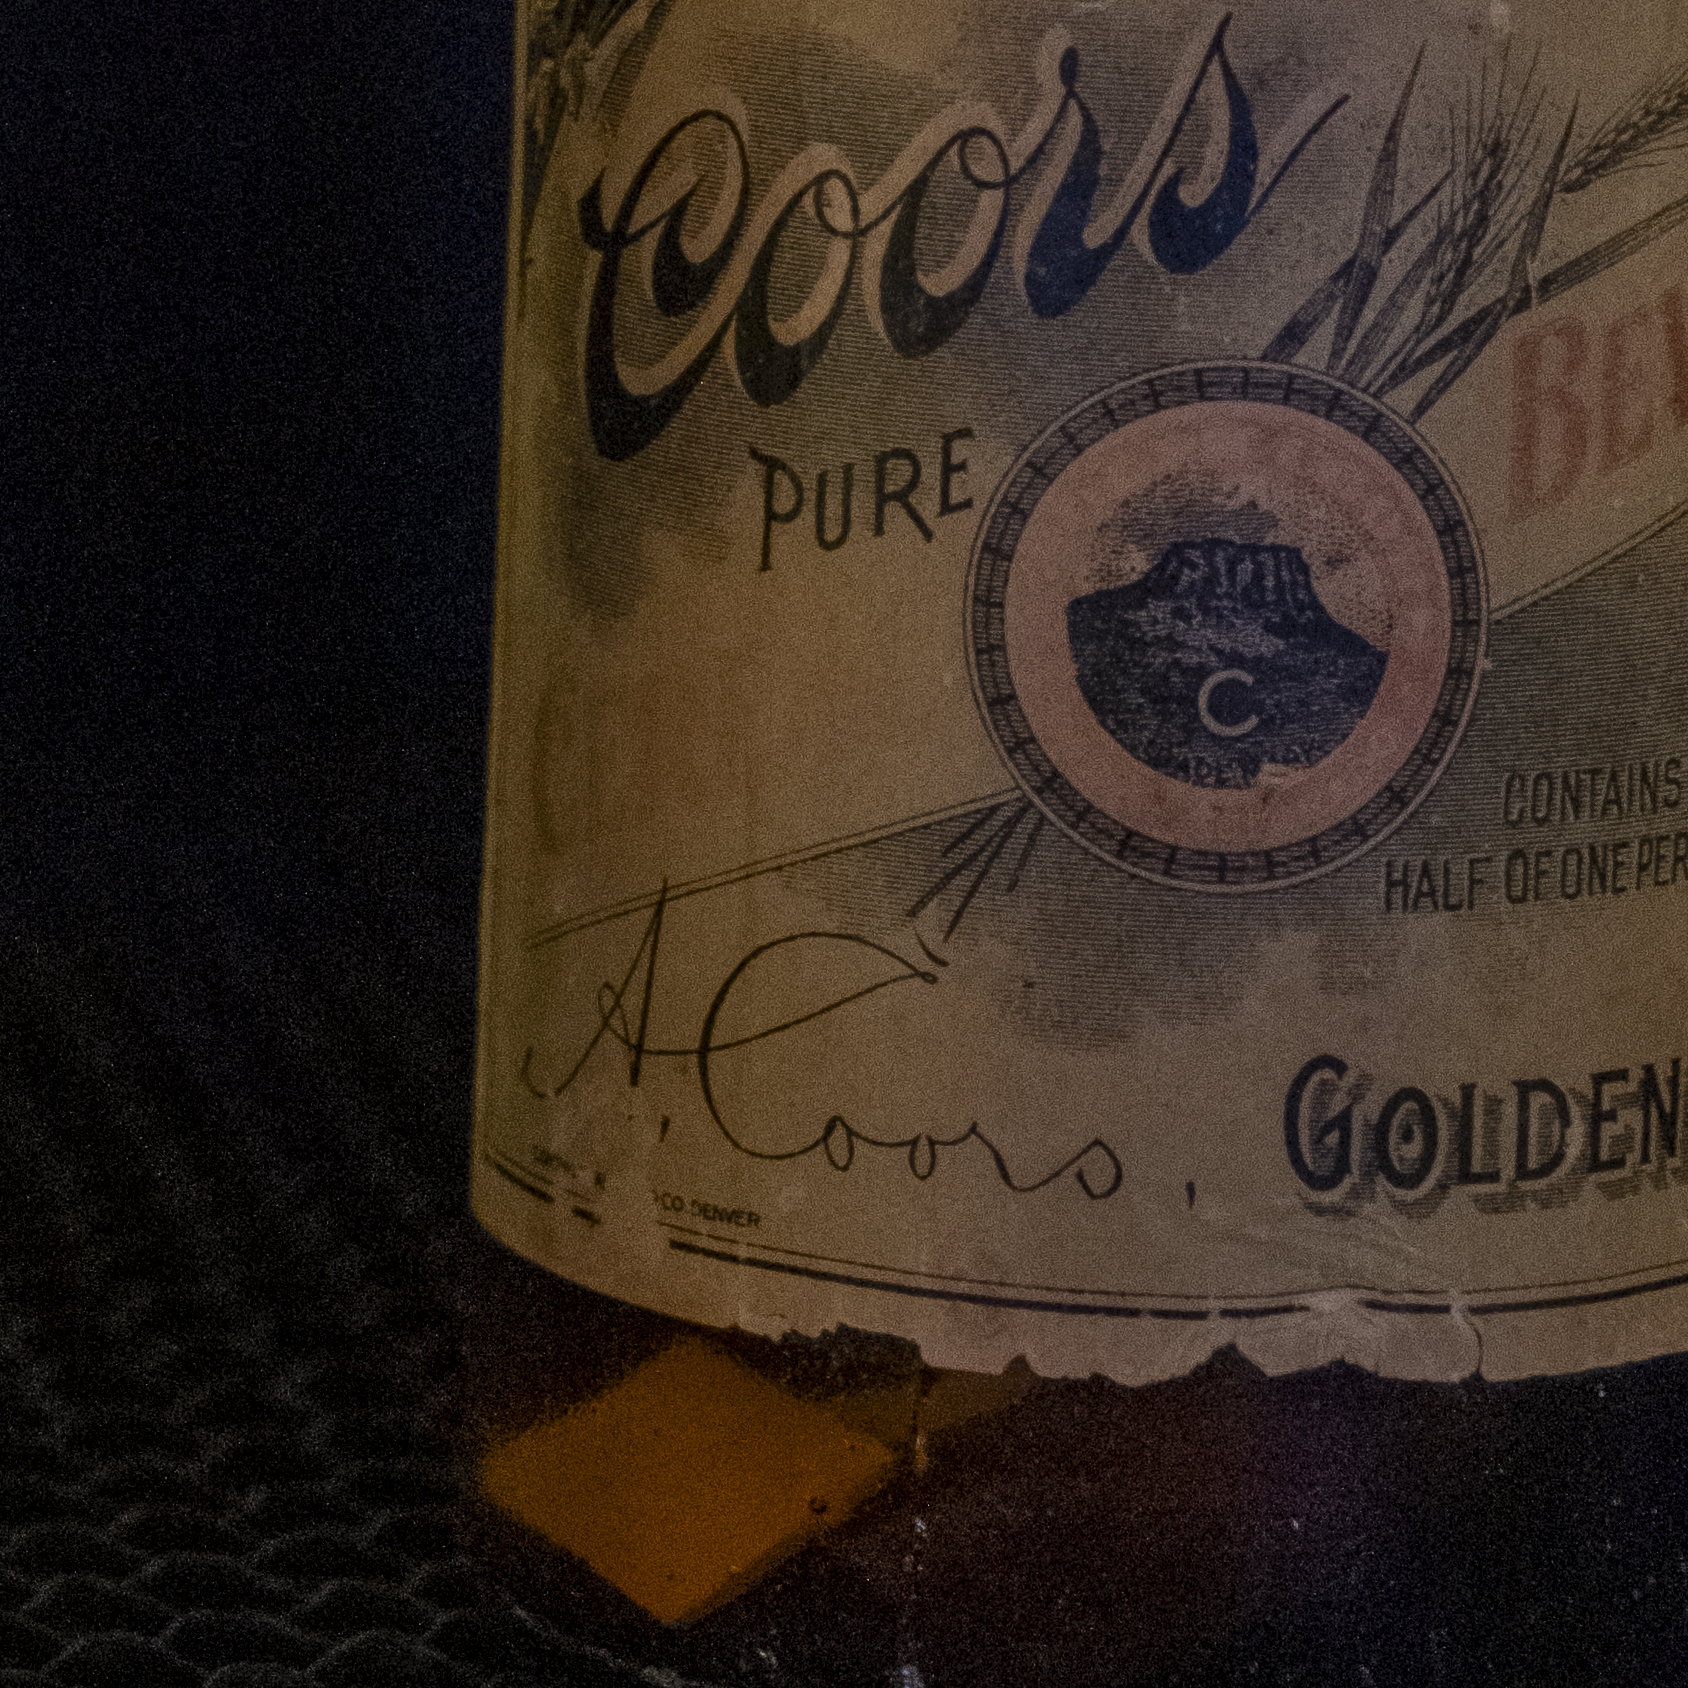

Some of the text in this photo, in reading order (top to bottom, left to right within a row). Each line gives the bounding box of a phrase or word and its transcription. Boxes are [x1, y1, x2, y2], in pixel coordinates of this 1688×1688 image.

[576, 8, 1352, 464] Coors
[748, 426, 977, 572] PURE
[1198, 670, 1259, 737] C
[1502, 757, 1684, 825] CONTAINS
[1383, 856, 1493, 913] HALF
[1504, 846, 1555, 905] OF
[1561, 839, 1631, 901] ONE
[1283, 1054, 1685, 1195] GOLDEN
